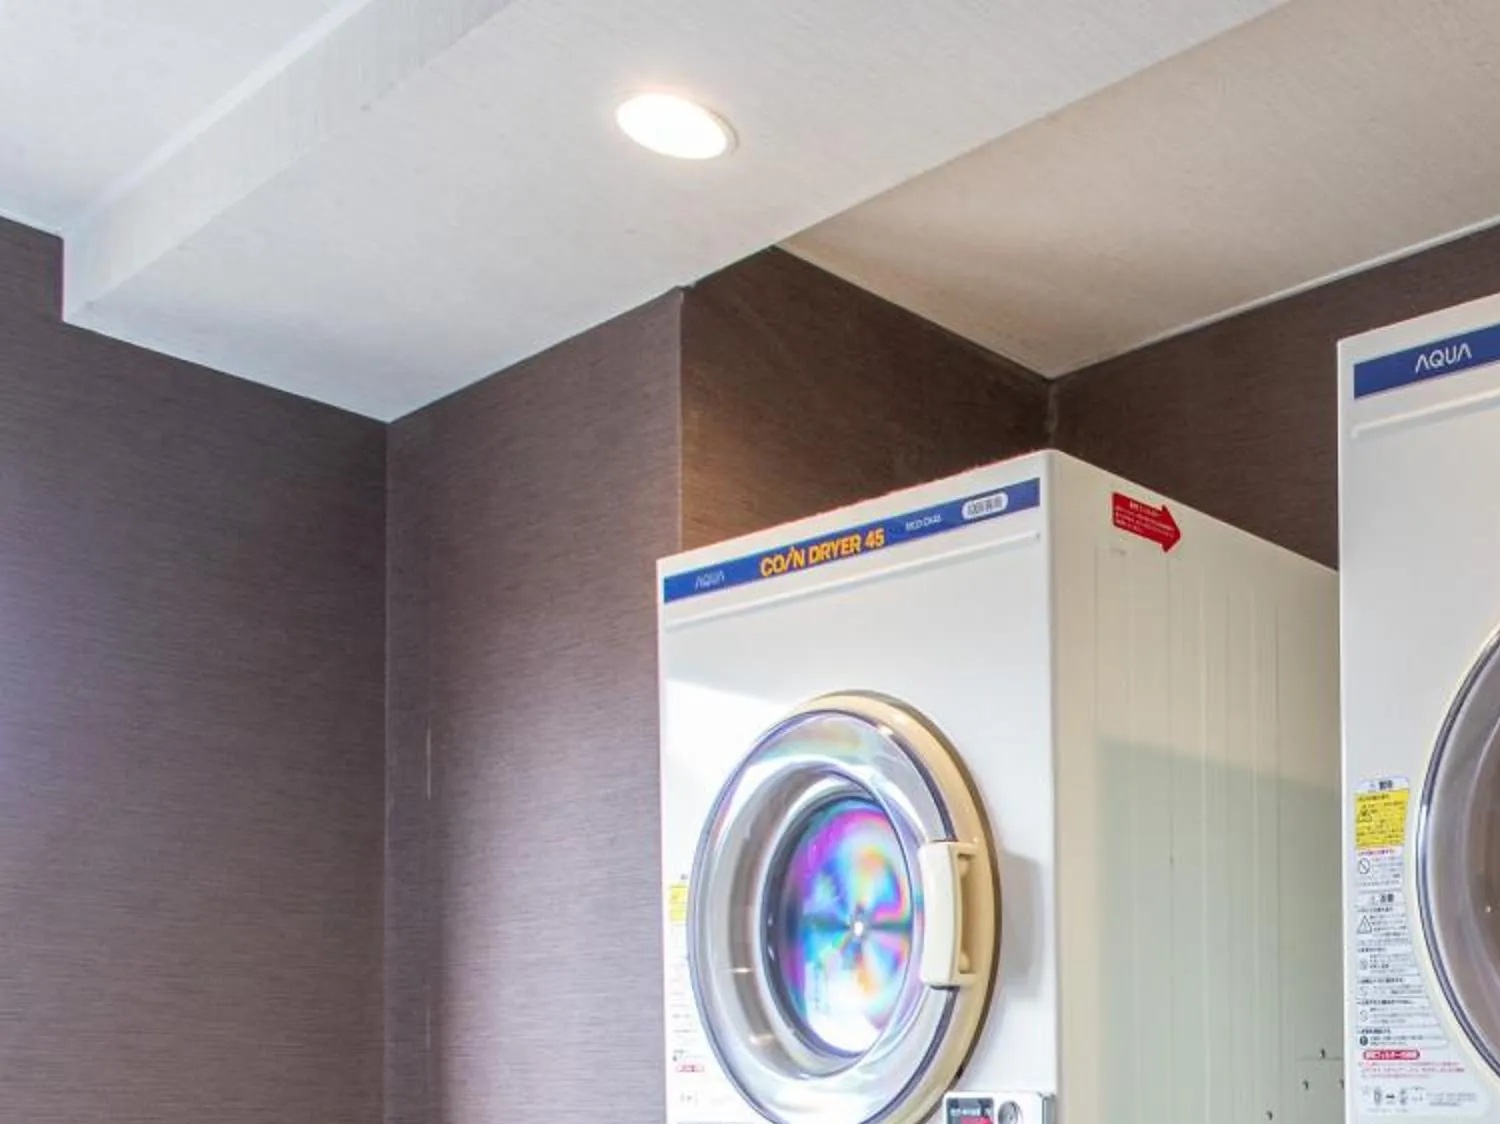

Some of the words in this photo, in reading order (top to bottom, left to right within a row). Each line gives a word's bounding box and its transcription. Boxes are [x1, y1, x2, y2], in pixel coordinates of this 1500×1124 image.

[1414, 342, 1472, 374] AQUA
[808, 533, 862, 565] DRYER
[864, 527, 886, 550] 45
